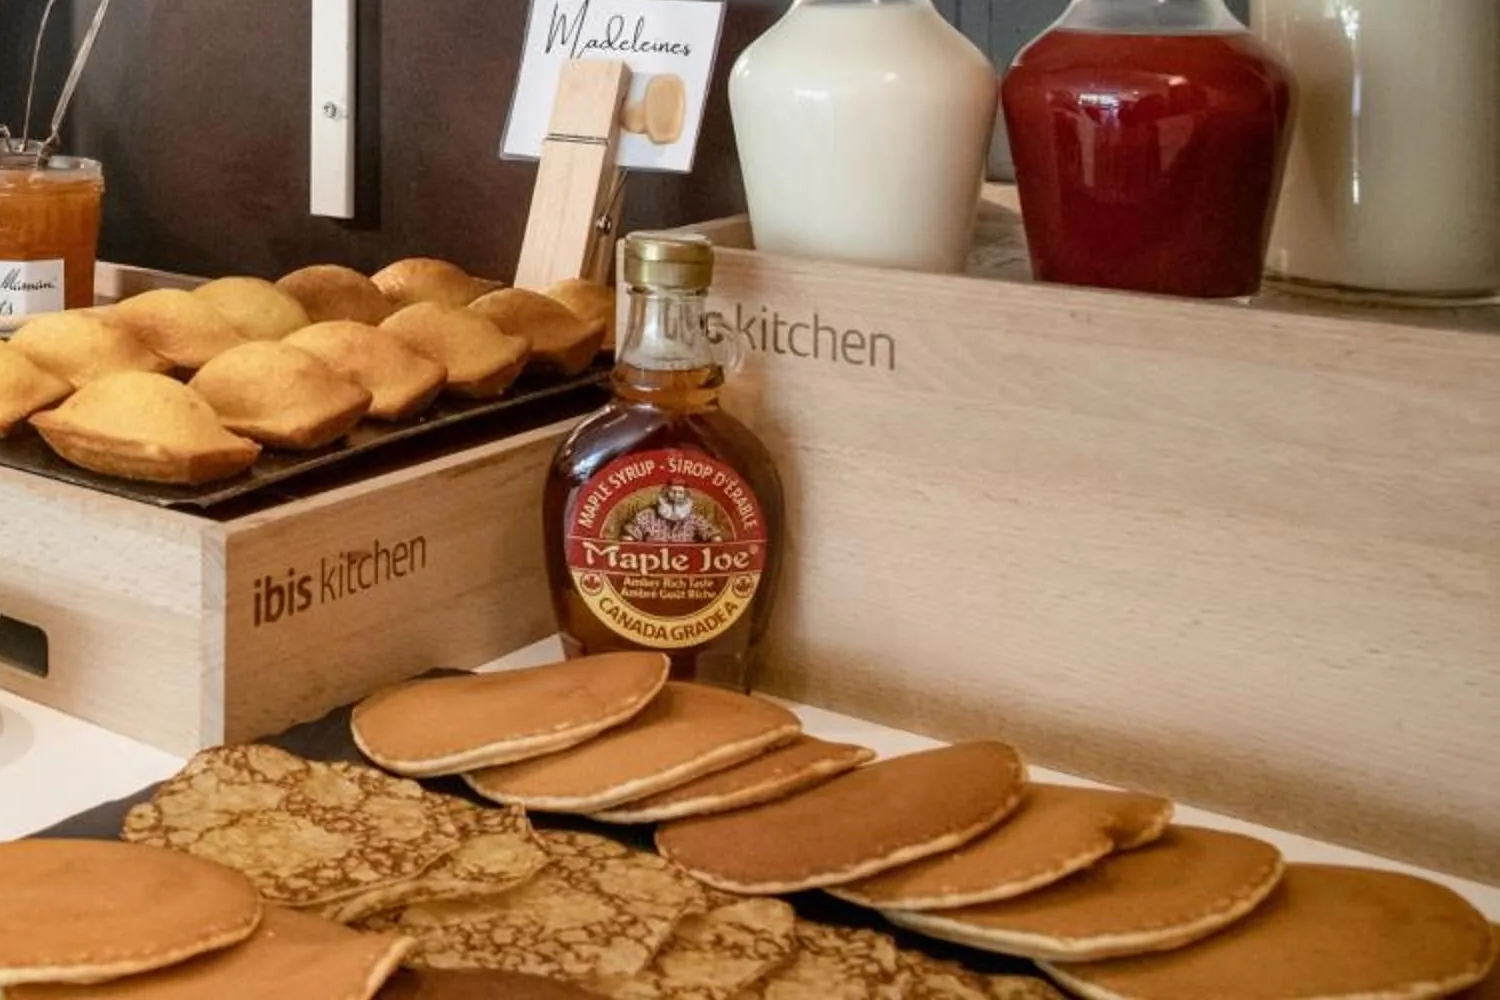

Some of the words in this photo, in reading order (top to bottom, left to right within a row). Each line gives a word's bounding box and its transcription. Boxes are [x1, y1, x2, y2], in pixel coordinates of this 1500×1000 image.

[736, 303, 895, 370] kitchen
[578, 484, 613, 529] MAPLE
[608, 459, 655, 489] SYRUP
[668, 457, 713, 480] SIROP
[253, 567, 313, 627] ibis
[320, 536, 426, 604] kitchen
[582, 541, 690, 574] Maple
[700, 548, 750, 572] Joe
[599, 597, 668, 641] CANADA
[669, 608, 727, 641] GRADE
[723, 600, 739, 617] A
